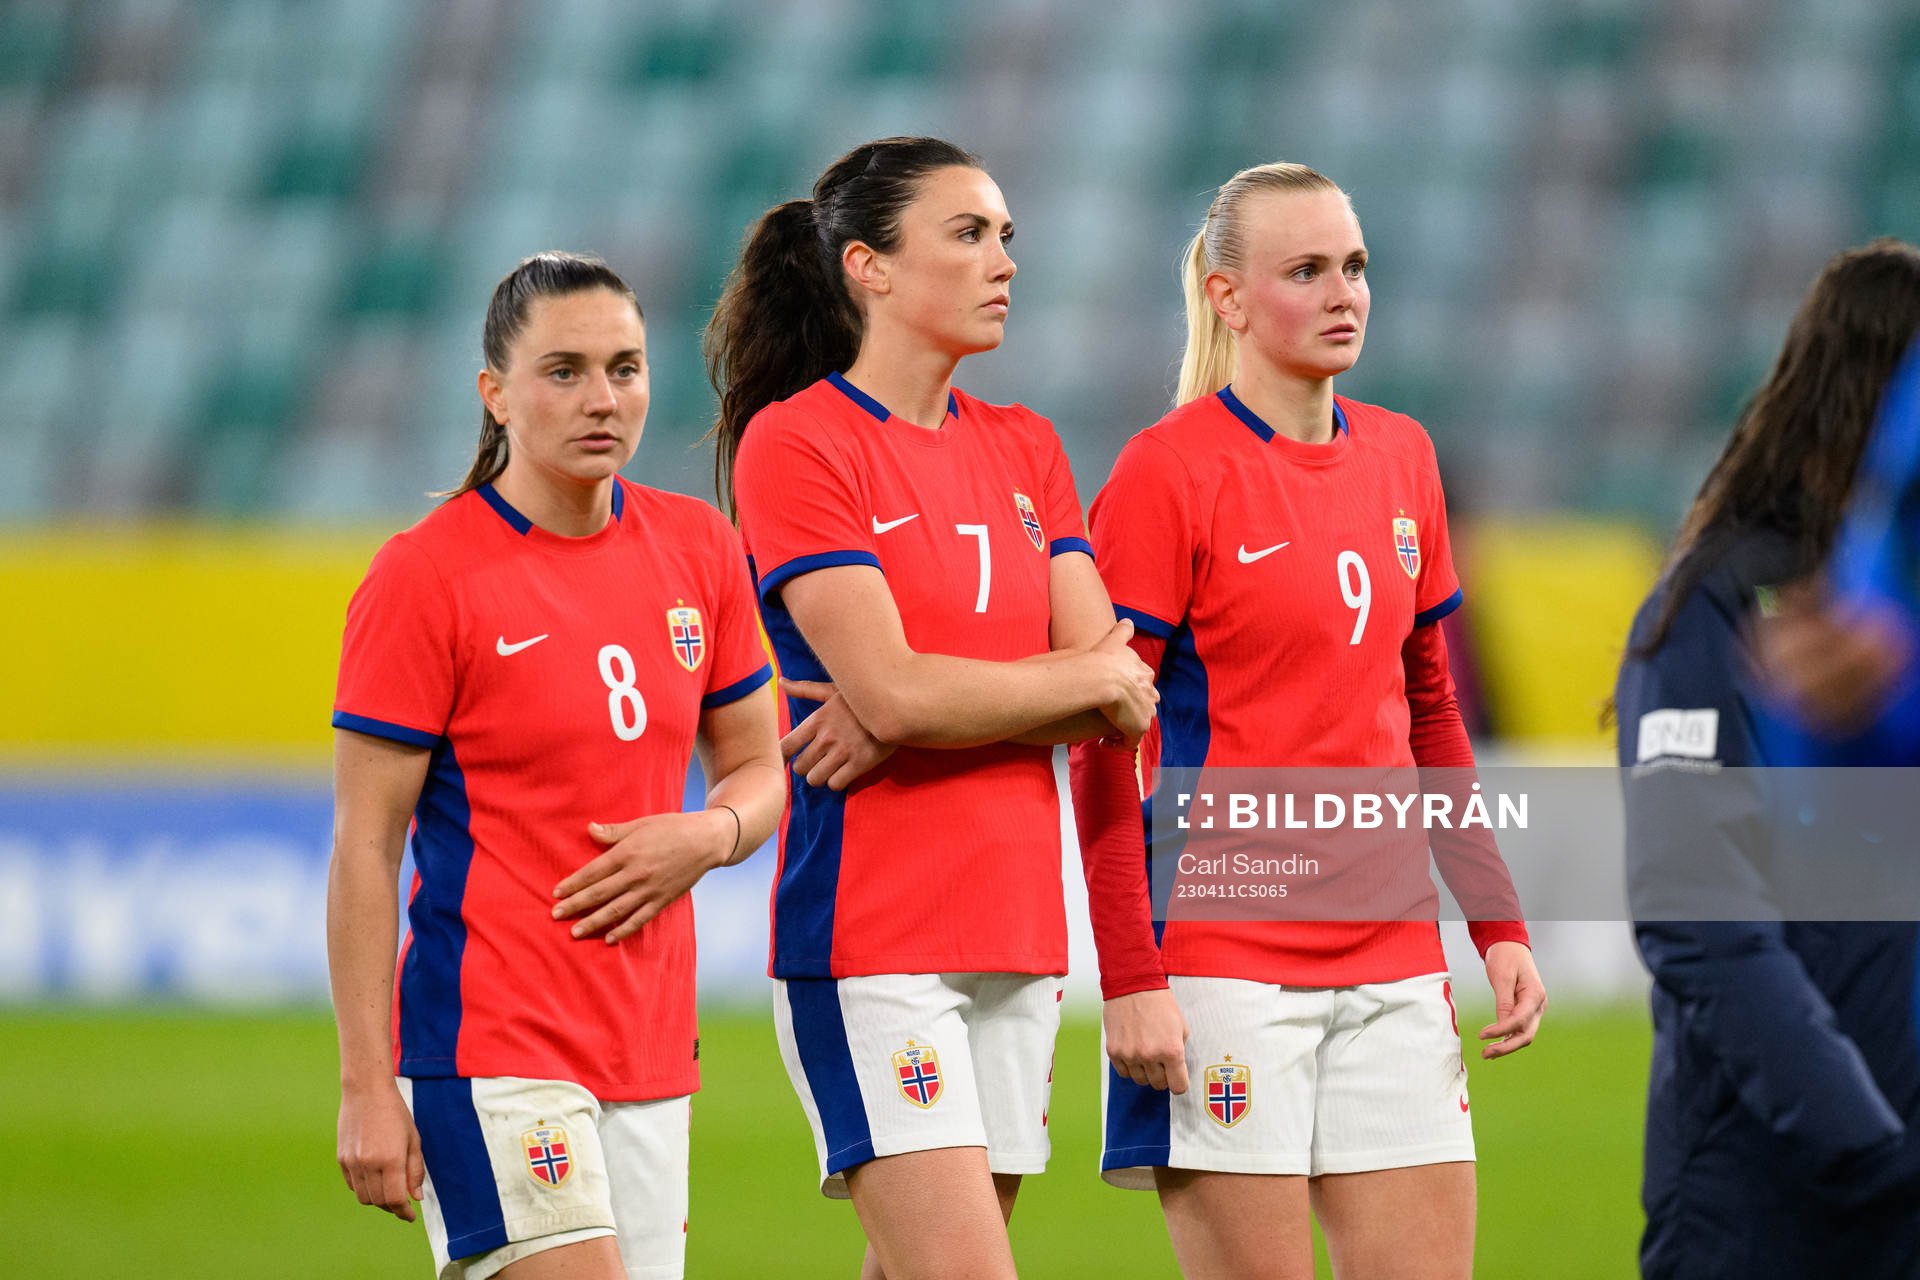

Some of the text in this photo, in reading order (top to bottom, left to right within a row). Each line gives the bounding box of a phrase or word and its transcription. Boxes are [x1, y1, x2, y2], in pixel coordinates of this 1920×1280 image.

[955, 523, 991, 613] 7
[1337, 550, 1371, 645] 9
[597, 644, 647, 741] 8
